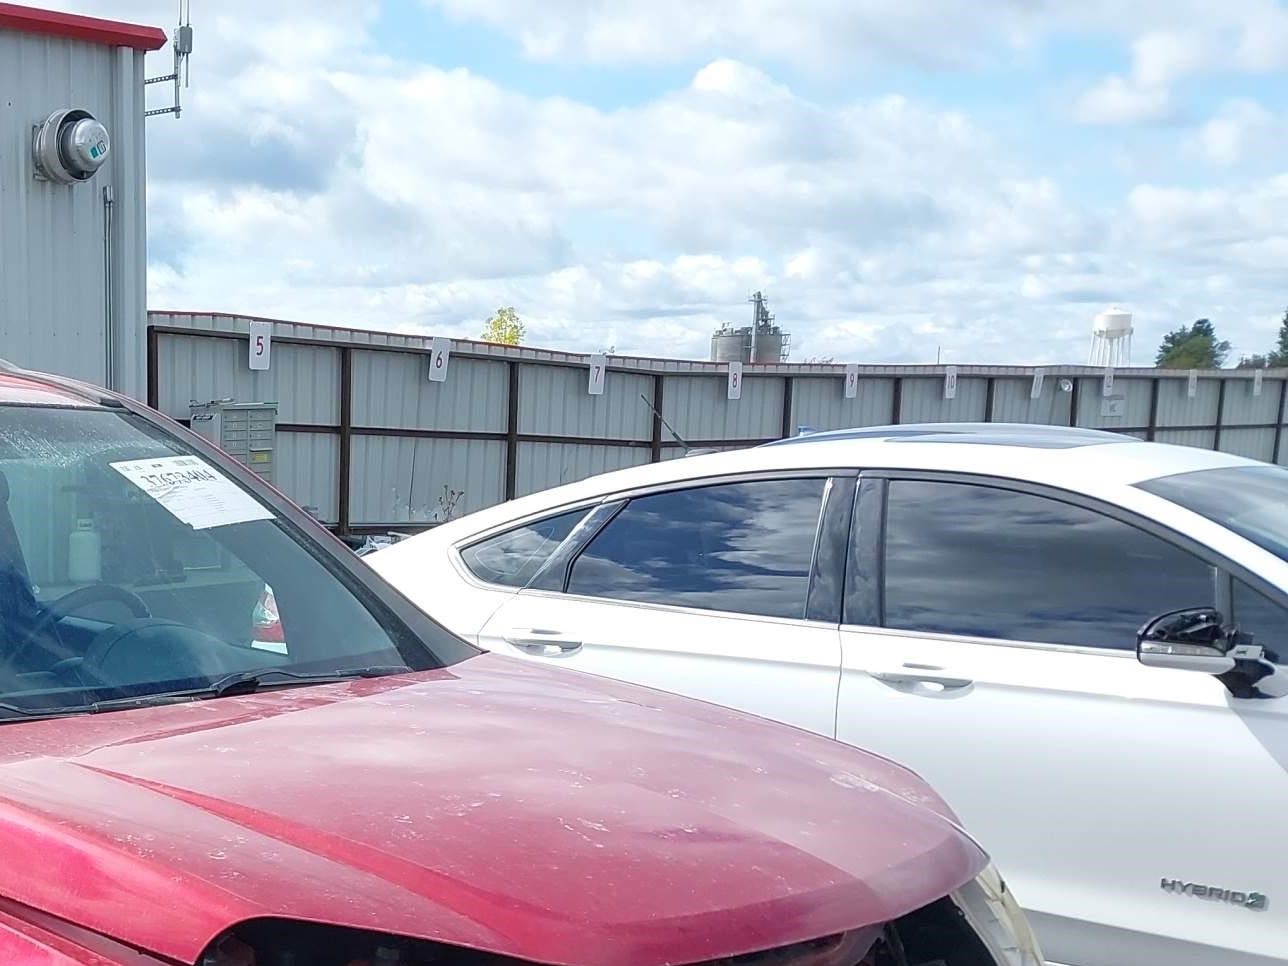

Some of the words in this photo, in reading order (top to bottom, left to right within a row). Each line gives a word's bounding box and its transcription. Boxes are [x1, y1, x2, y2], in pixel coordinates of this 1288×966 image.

[256, 335, 264, 356] 5
[435, 351, 443, 369] 6
[594, 366, 601, 383] 7
[731, 372, 738, 388] 8
[849, 373, 855, 388] 9
[948, 375, 956, 389] 10
[1160, 878, 1247, 904] HYBRID
